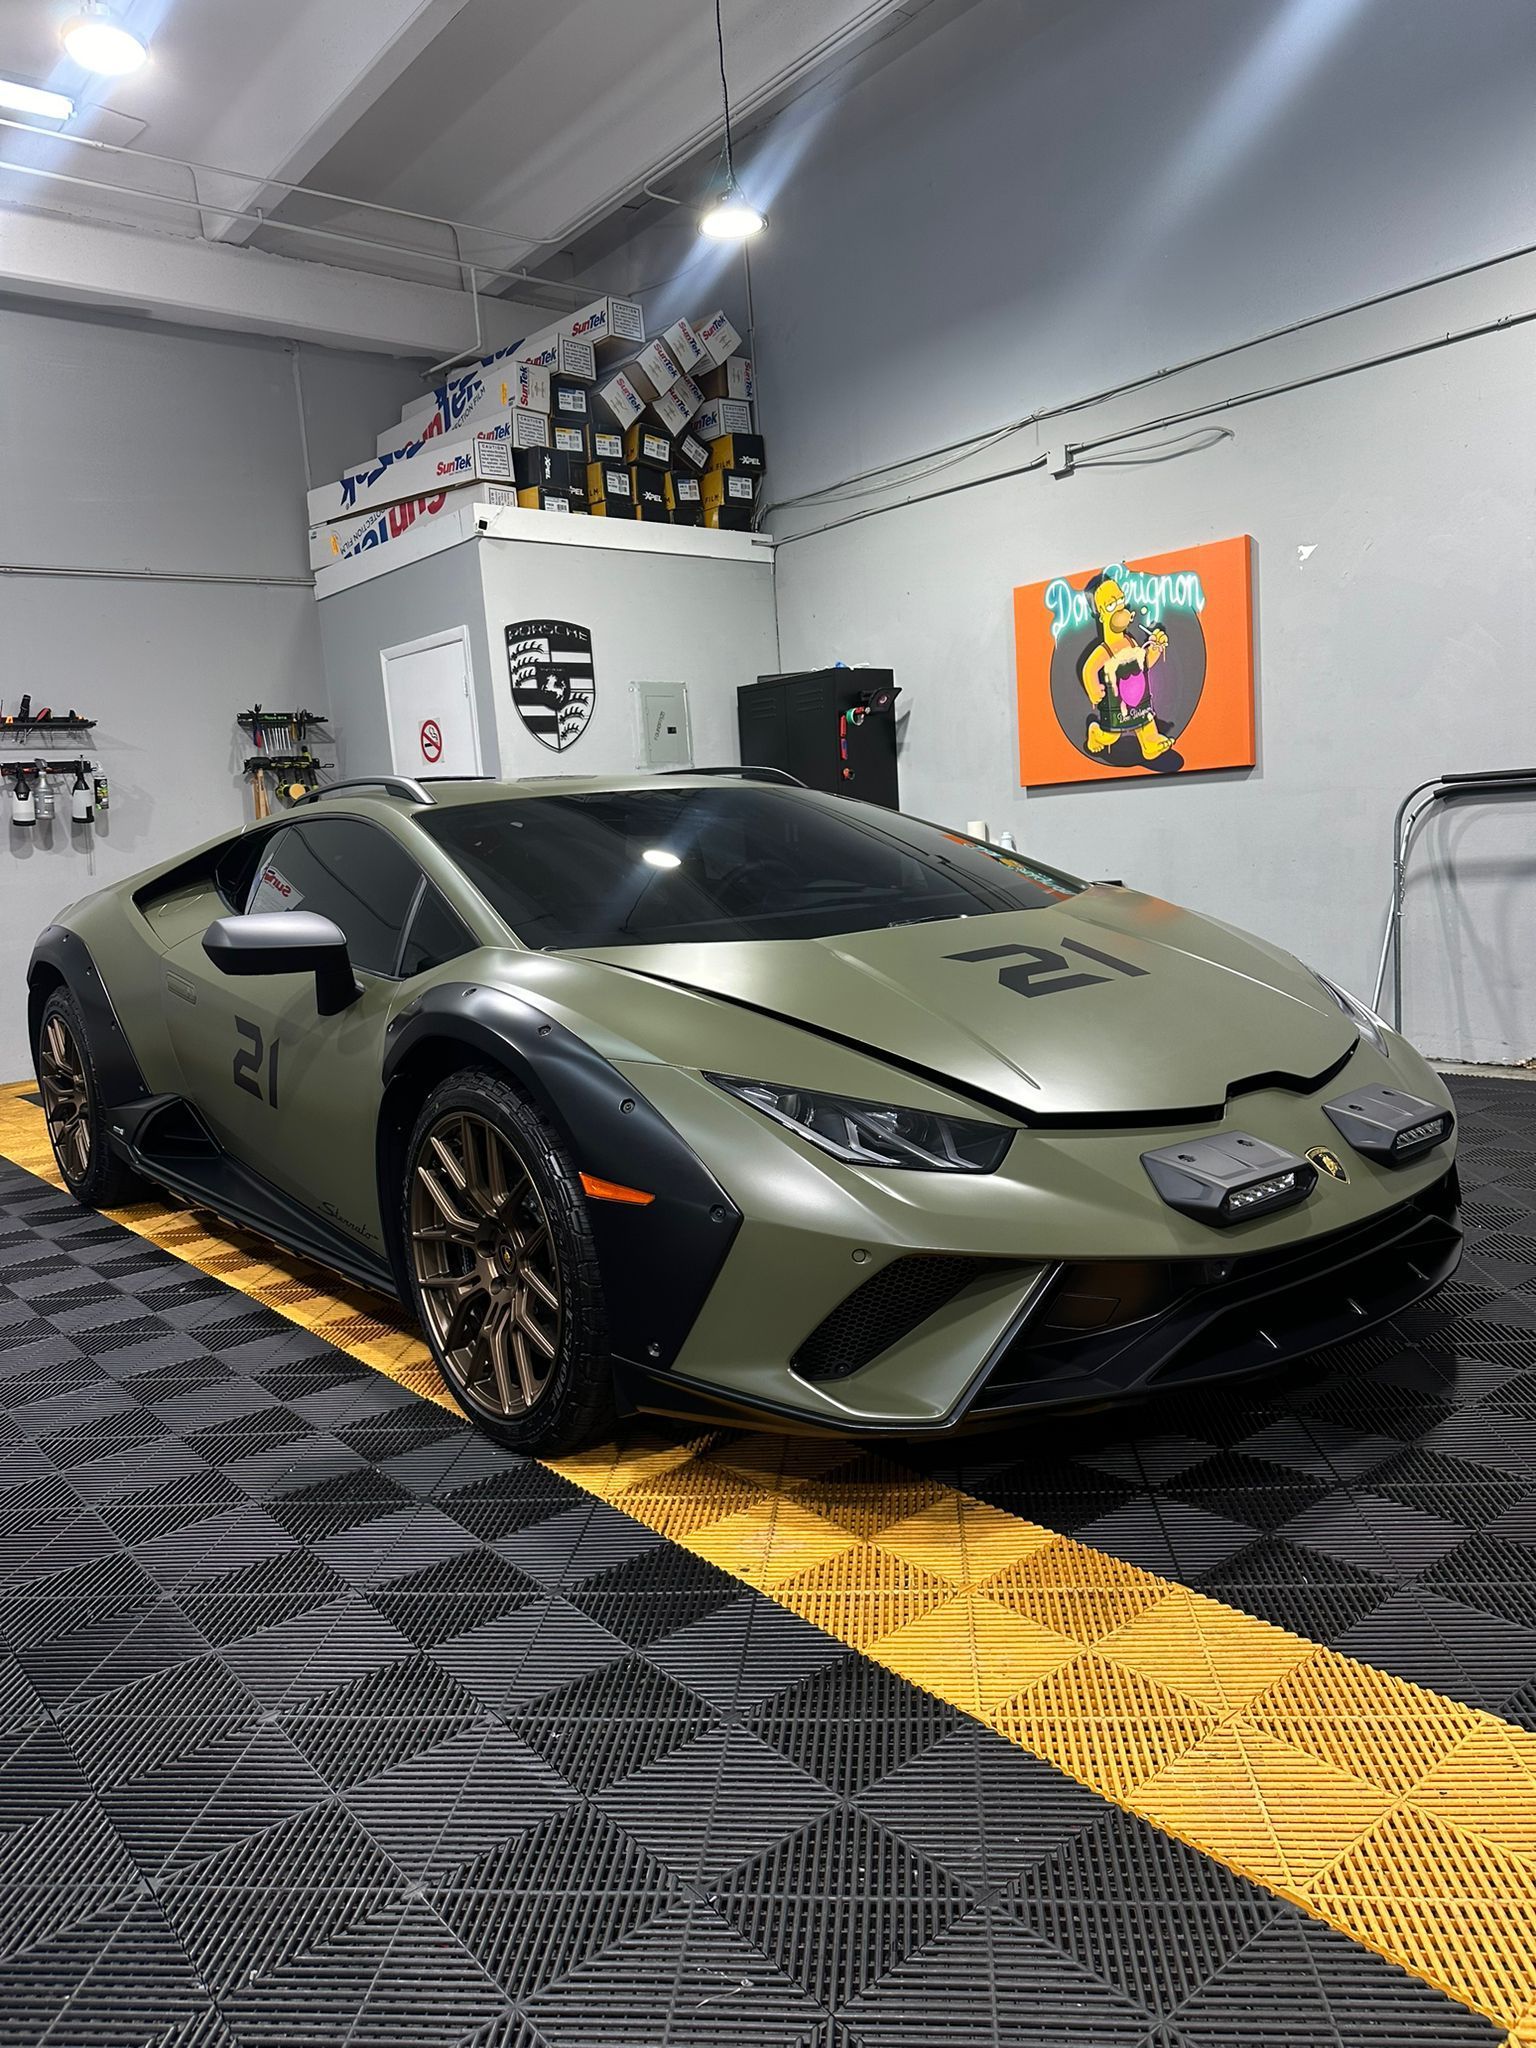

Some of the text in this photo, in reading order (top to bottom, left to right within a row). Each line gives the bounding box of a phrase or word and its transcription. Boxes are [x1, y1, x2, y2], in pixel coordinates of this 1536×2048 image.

[572, 310, 606, 336] SunTek
[702, 315, 726, 341] SunTek
[678, 320, 701, 357] SunTek
[653, 343, 679, 379] SunTek
[520, 366, 529, 406] SunTek
[616, 377, 642, 413] SunTek
[682, 373, 704, 401] unTek
[691, 411, 718, 431] unTek
[437, 453, 472, 476] SunTek
[544, 454, 552, 479] XPEL
[740, 456, 761, 465] XPEL
[569, 485, 584, 496] PEL
[642, 491, 663, 502] XPEL
[508, 624, 588, 641] PORSCHE
[939, 937, 1151, 998] 21
[233, 1015, 280, 1109] 21
